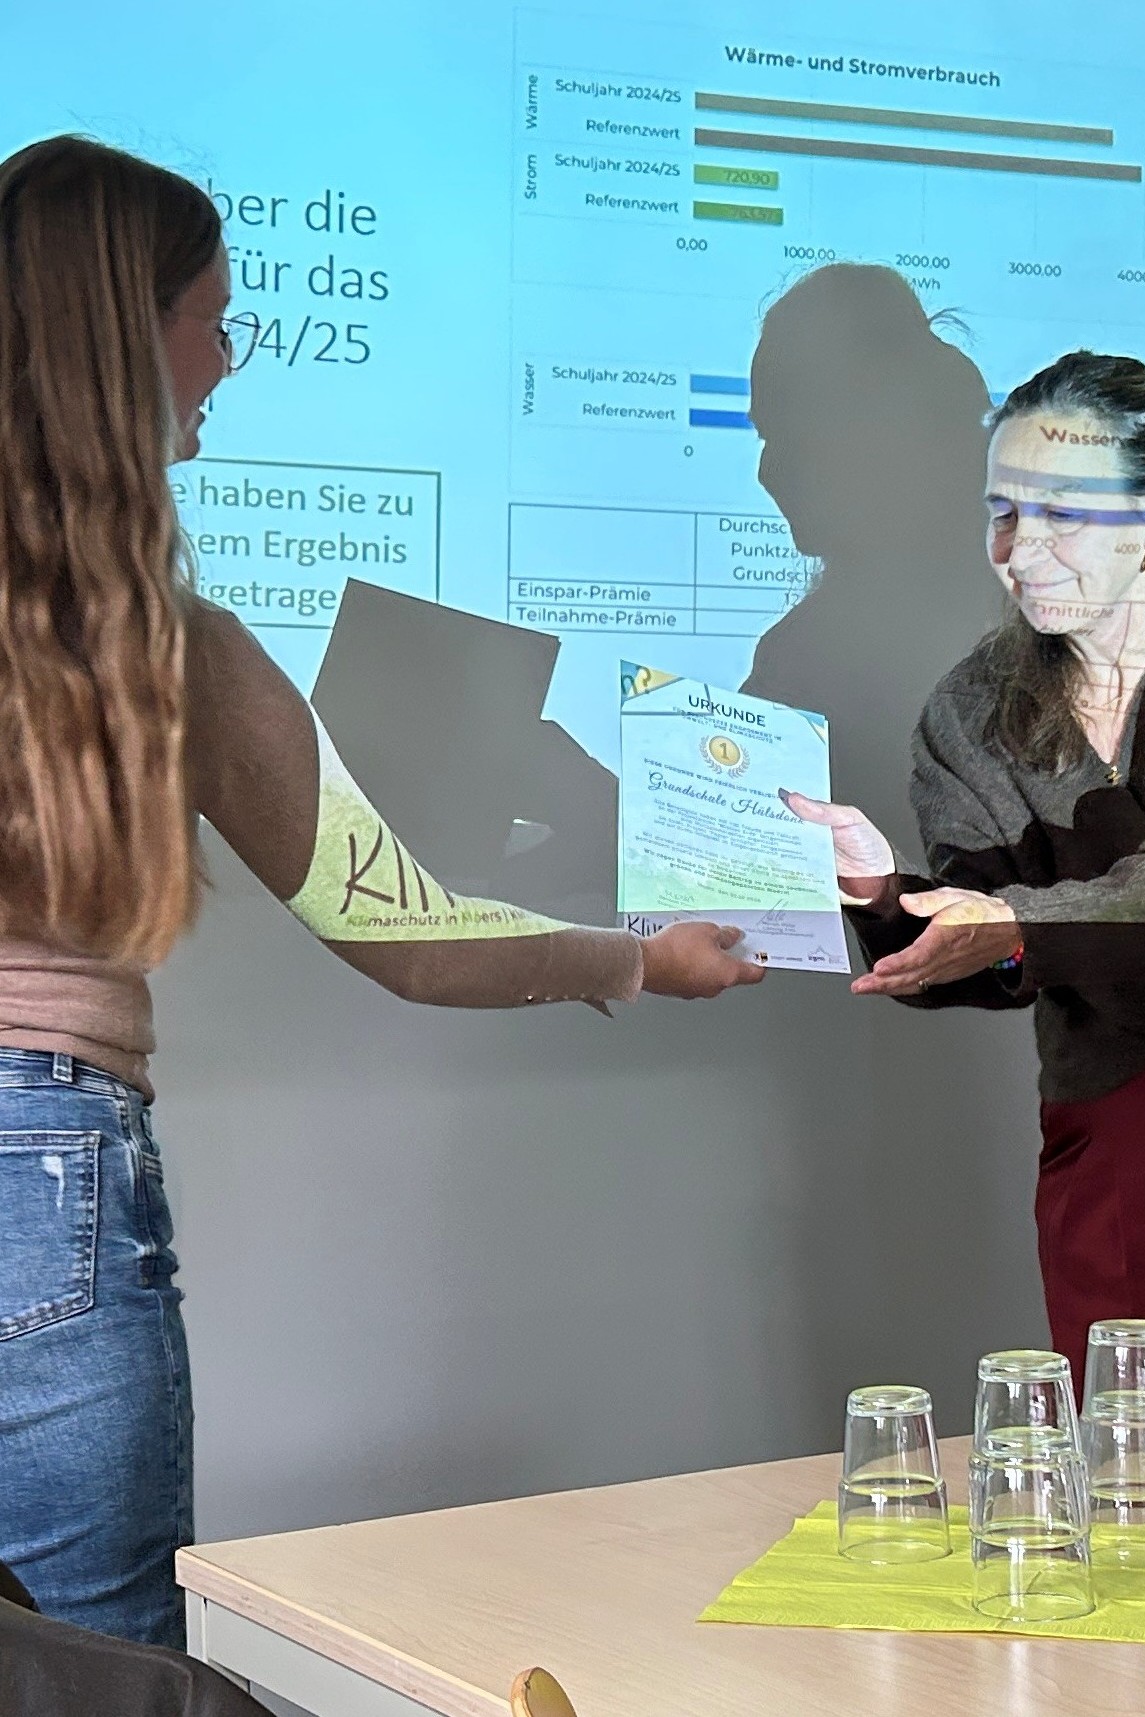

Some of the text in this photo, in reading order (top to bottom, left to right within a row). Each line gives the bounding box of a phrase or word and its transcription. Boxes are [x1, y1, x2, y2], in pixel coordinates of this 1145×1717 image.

[725, 45, 1000, 88] Wärme- und Stromverbrauch
[525, 74, 539, 130] Wärme
[555, 78, 681, 104] Schuljahr 2024/25
[586, 119, 680, 141] Referenzwert
[525, 154, 538, 199] Strom
[554, 153, 680, 178] Schuljahr 2024/25
[305, 189, 376, 235] die
[585, 193, 679, 215] Referenzwert
[676, 237, 707, 253] 0,00
[783, 245, 835, 263] 1000,00
[308, 254, 389, 300] das
[522, 362, 535, 415] Wasser
[552, 365, 676, 386] Schuljahr 2024/25
[582, 403, 676, 420] Referenzwert
[200, 476, 306, 510] haben
[318, 484, 366, 513] Sie
[377, 492, 413, 516] zu
[191, 530, 407, 566] em Ergebnis
[517, 582, 651, 601] Einspar-Prämie
[516, 607, 677, 627] Teilnahme-Prämie
[688, 694, 766, 728] URKUNDE
